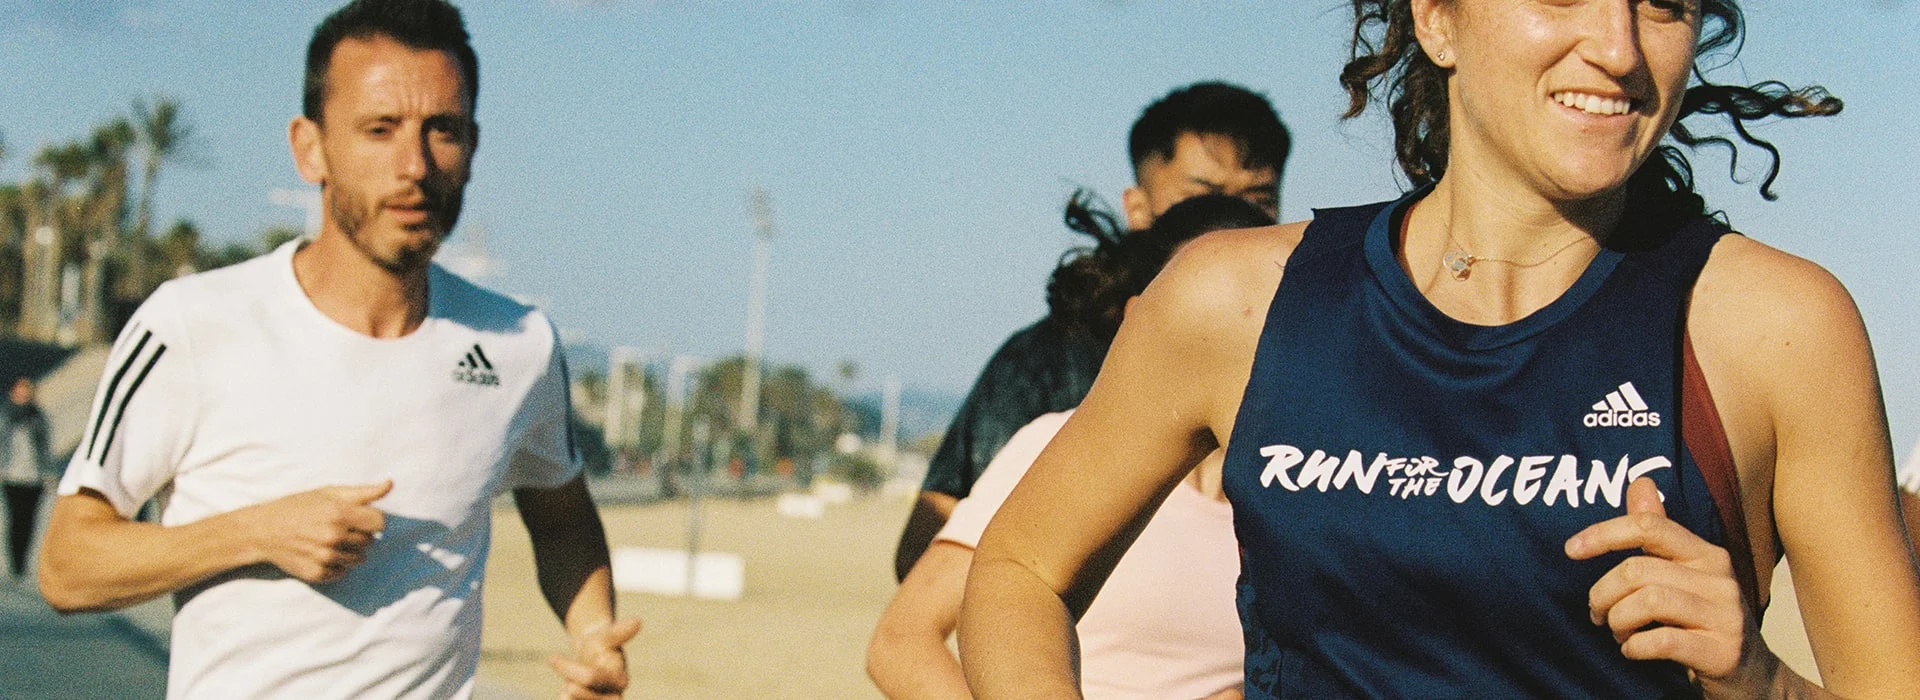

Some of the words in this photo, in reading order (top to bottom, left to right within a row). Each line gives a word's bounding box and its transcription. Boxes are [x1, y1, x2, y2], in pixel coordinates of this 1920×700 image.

[1583, 409, 1661, 427] adidas
[1260, 444, 1387, 494] RUN
[1386, 456, 1449, 477] FOR
[1388, 477, 1443, 500] THE
